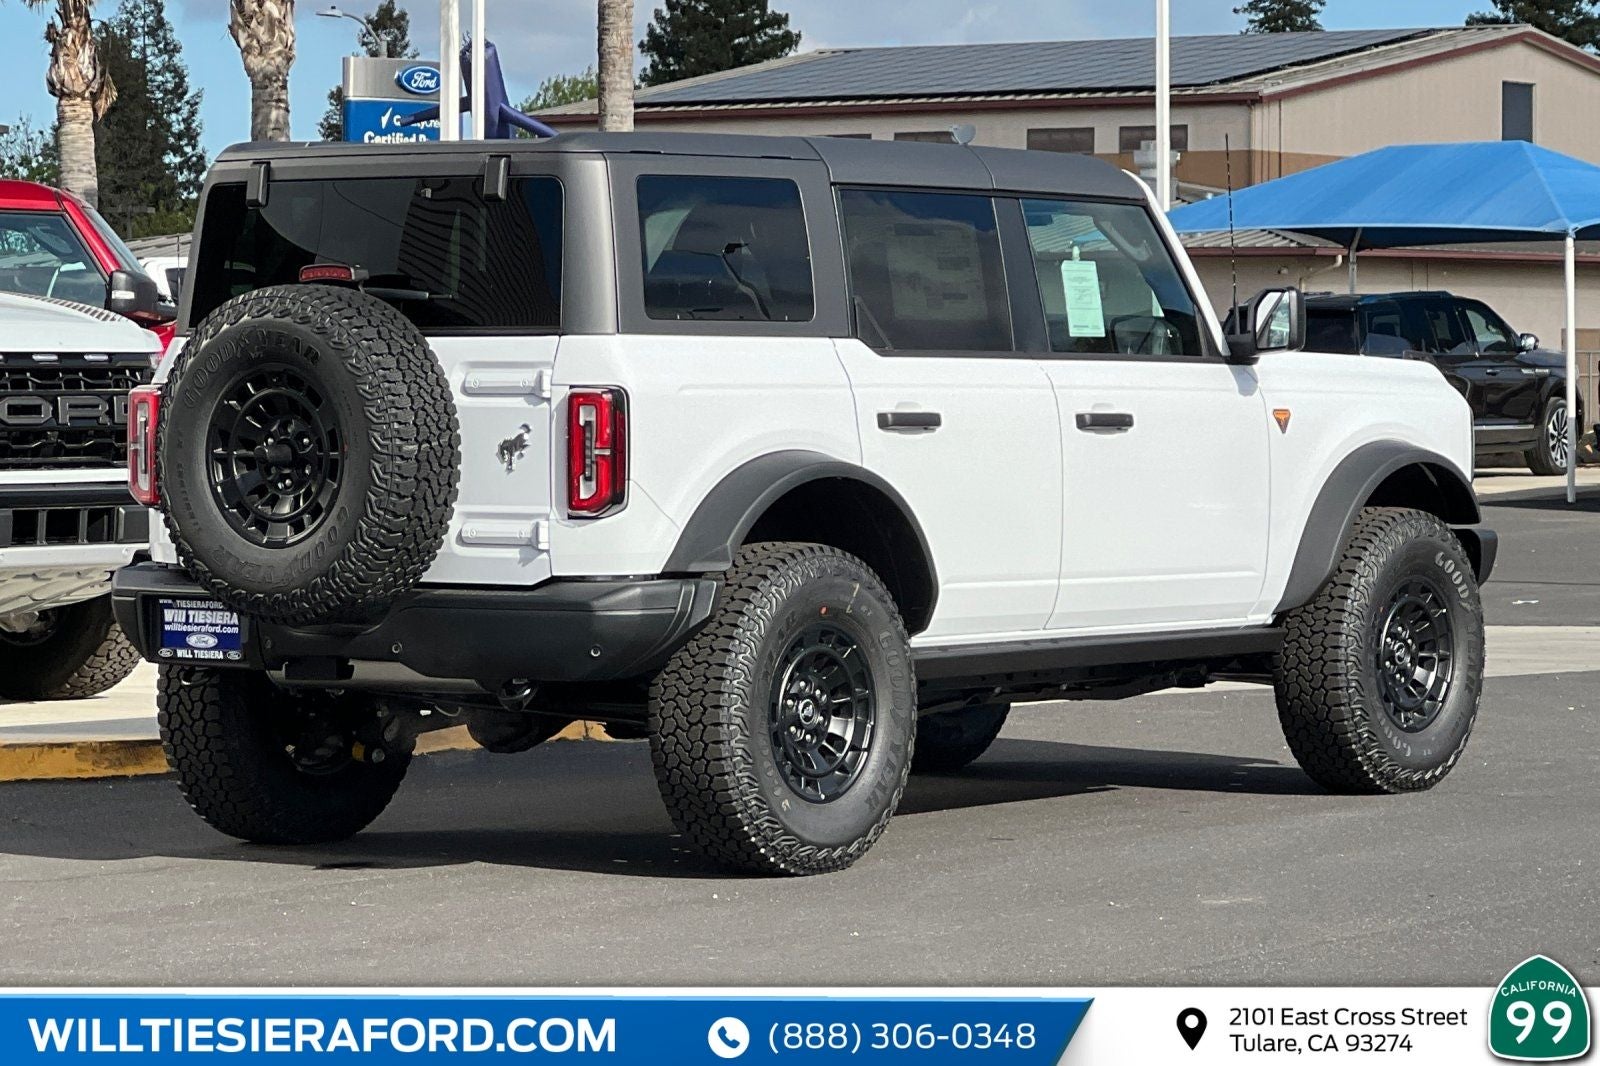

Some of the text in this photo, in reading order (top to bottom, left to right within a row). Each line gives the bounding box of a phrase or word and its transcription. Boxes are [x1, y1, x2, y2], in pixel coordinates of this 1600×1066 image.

[411, 71, 436, 88] Ford
[0, 396, 128, 424] OR
[188, 610, 239, 625] TIESIERA
[164, 623, 239, 633] willtiesieraford.com
[176, 649, 224, 660] WILL TIESIERA
